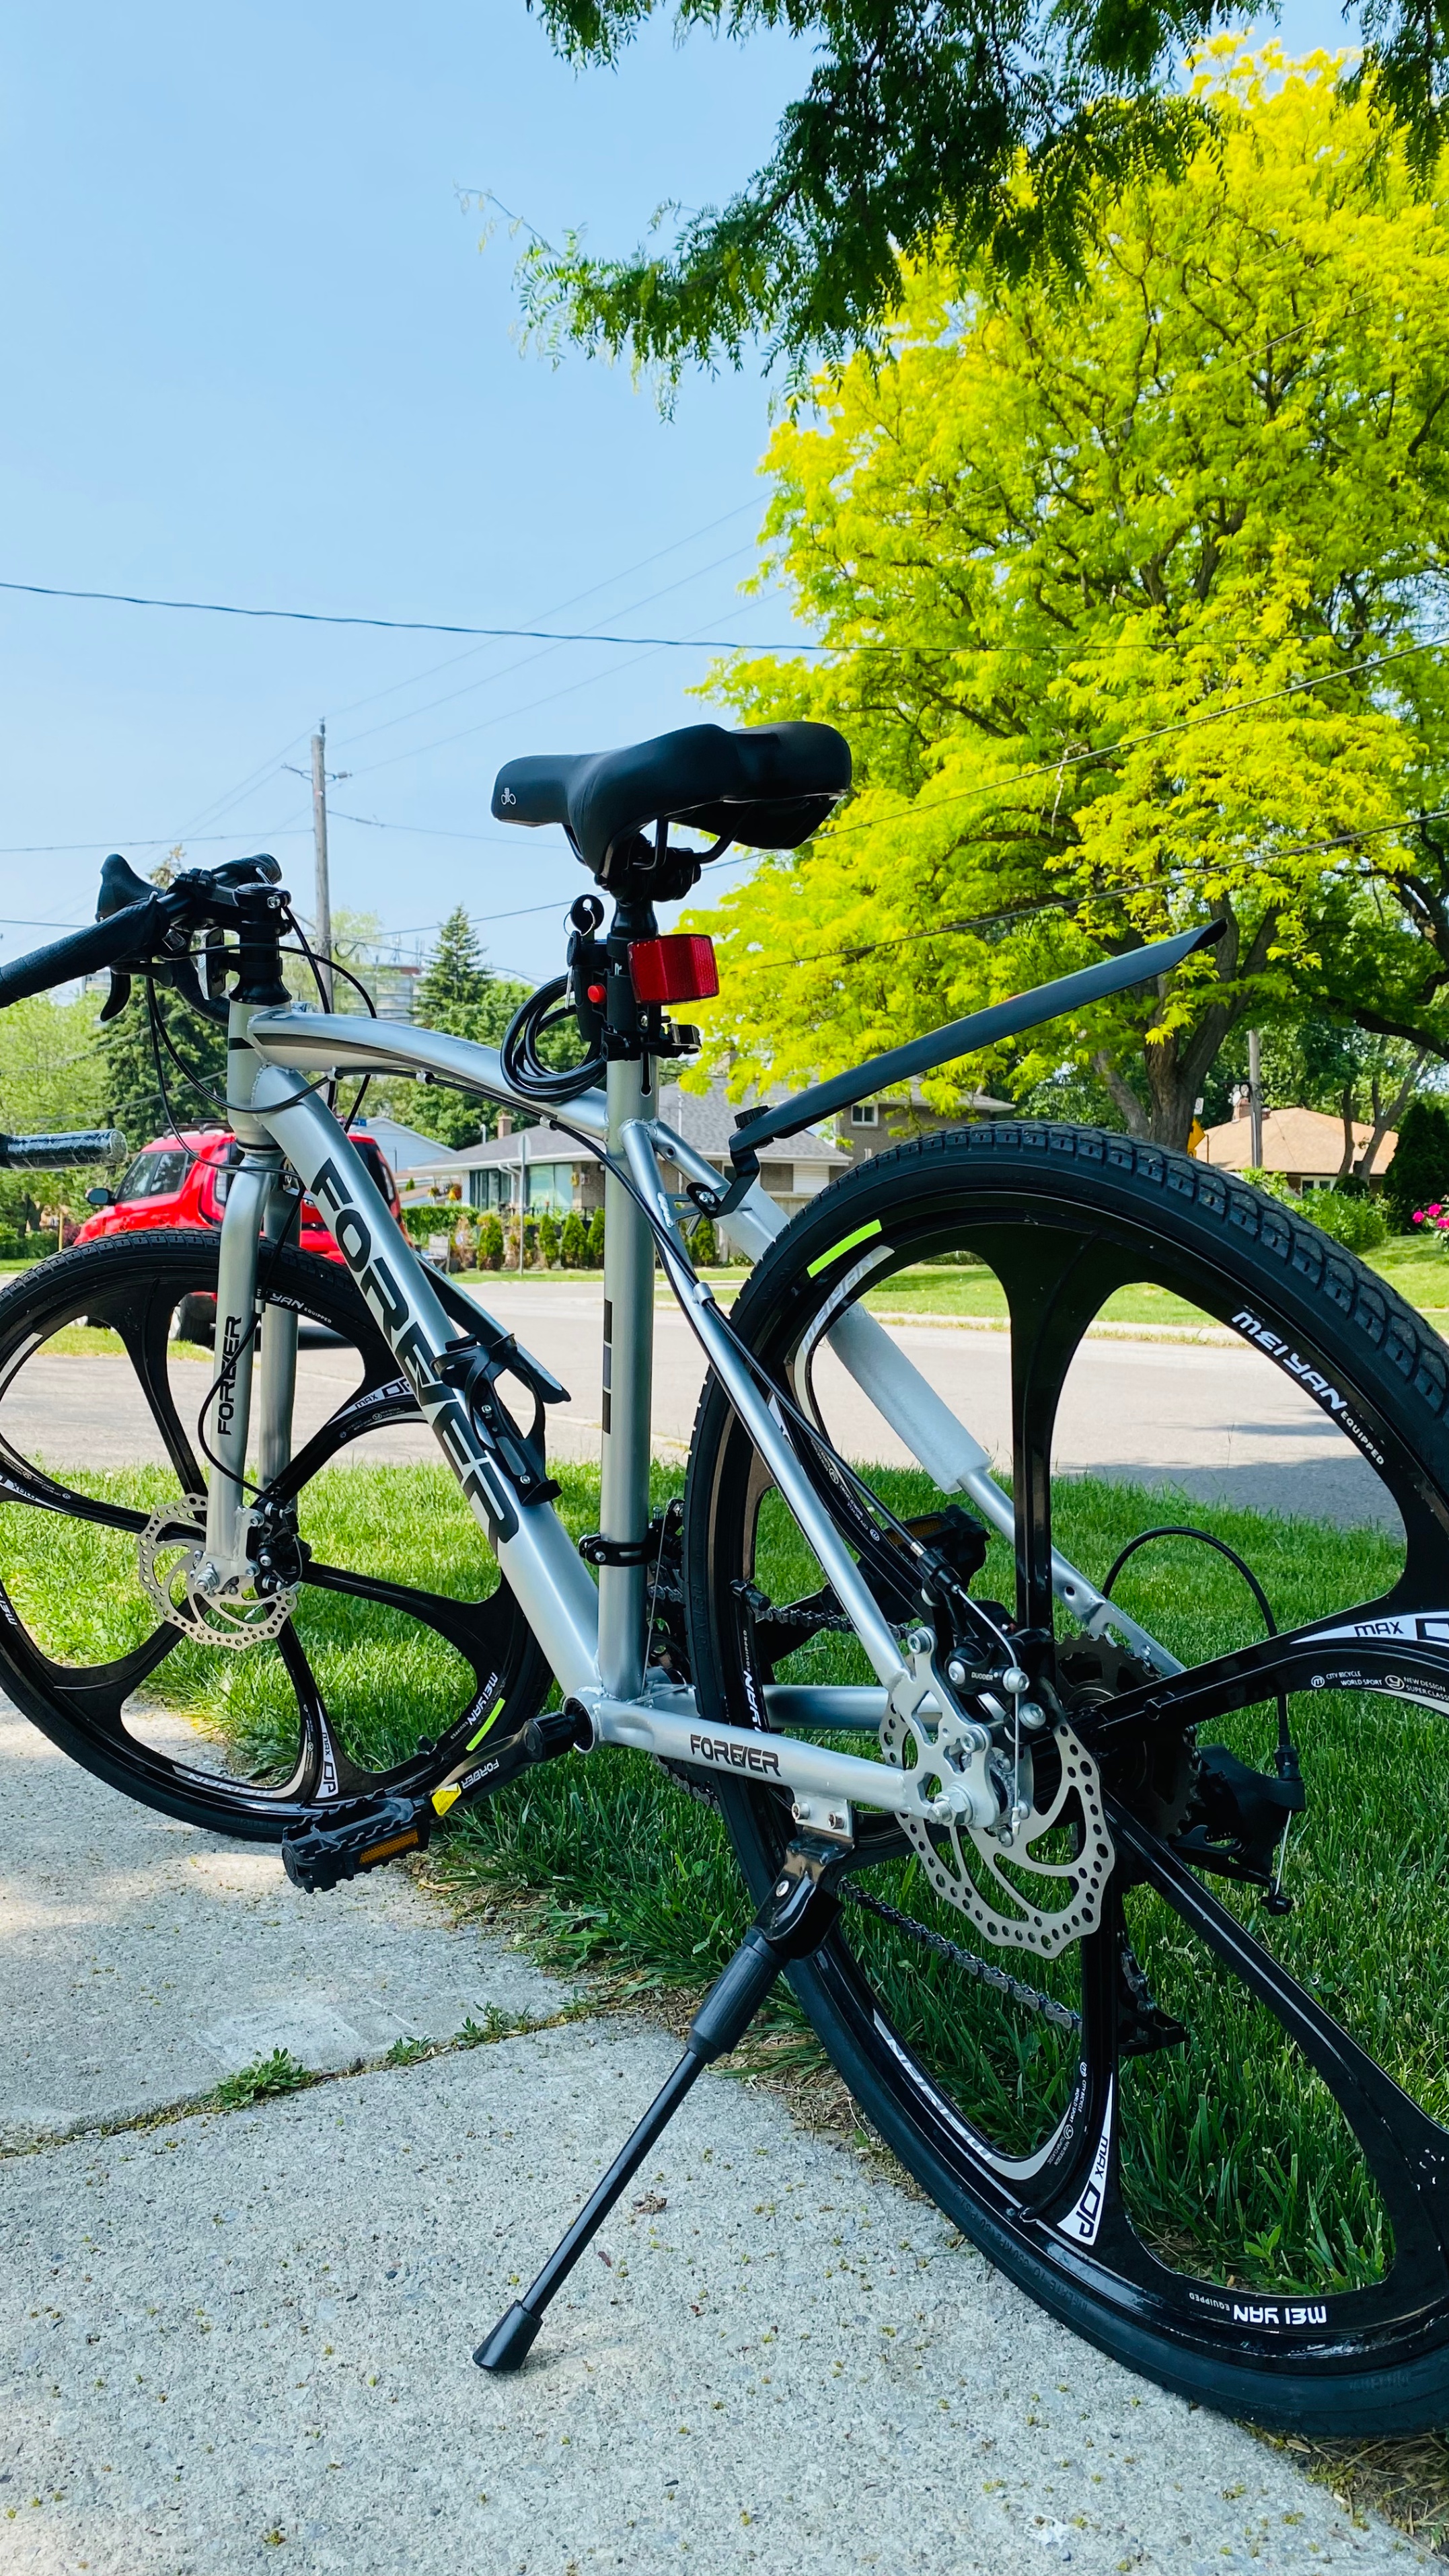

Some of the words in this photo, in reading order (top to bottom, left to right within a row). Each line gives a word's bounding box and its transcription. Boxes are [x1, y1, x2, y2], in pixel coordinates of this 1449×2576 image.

[270, 1292, 304, 1310] YAN
[304, 1307, 332, 1324] EQUIPPED
[355, 1394, 378, 1410] MAX
[1340, 1410, 1384, 1465] EQUIPPED
[1354, 1622, 1404, 1637] MAX
[743, 1630, 751, 1672] EQUIPPED
[1326, 1672, 1337, 1680] CITY
[1403, 1677, 1419, 1685] NEW
[1420, 1679, 1446, 1692] DESIGN
[1406, 1685, 1427, 1694] SUPER
[1427, 1690, 1449, 1701] CLASS
[322, 1733, 332, 1756] MAX
[690, 1734, 782, 1777] FOREVER
[461, 1758, 500, 1789] FOREVER
[1094, 2135, 1108, 2179] MAX
[1189, 2292, 1230, 2311] EQUIPPED
